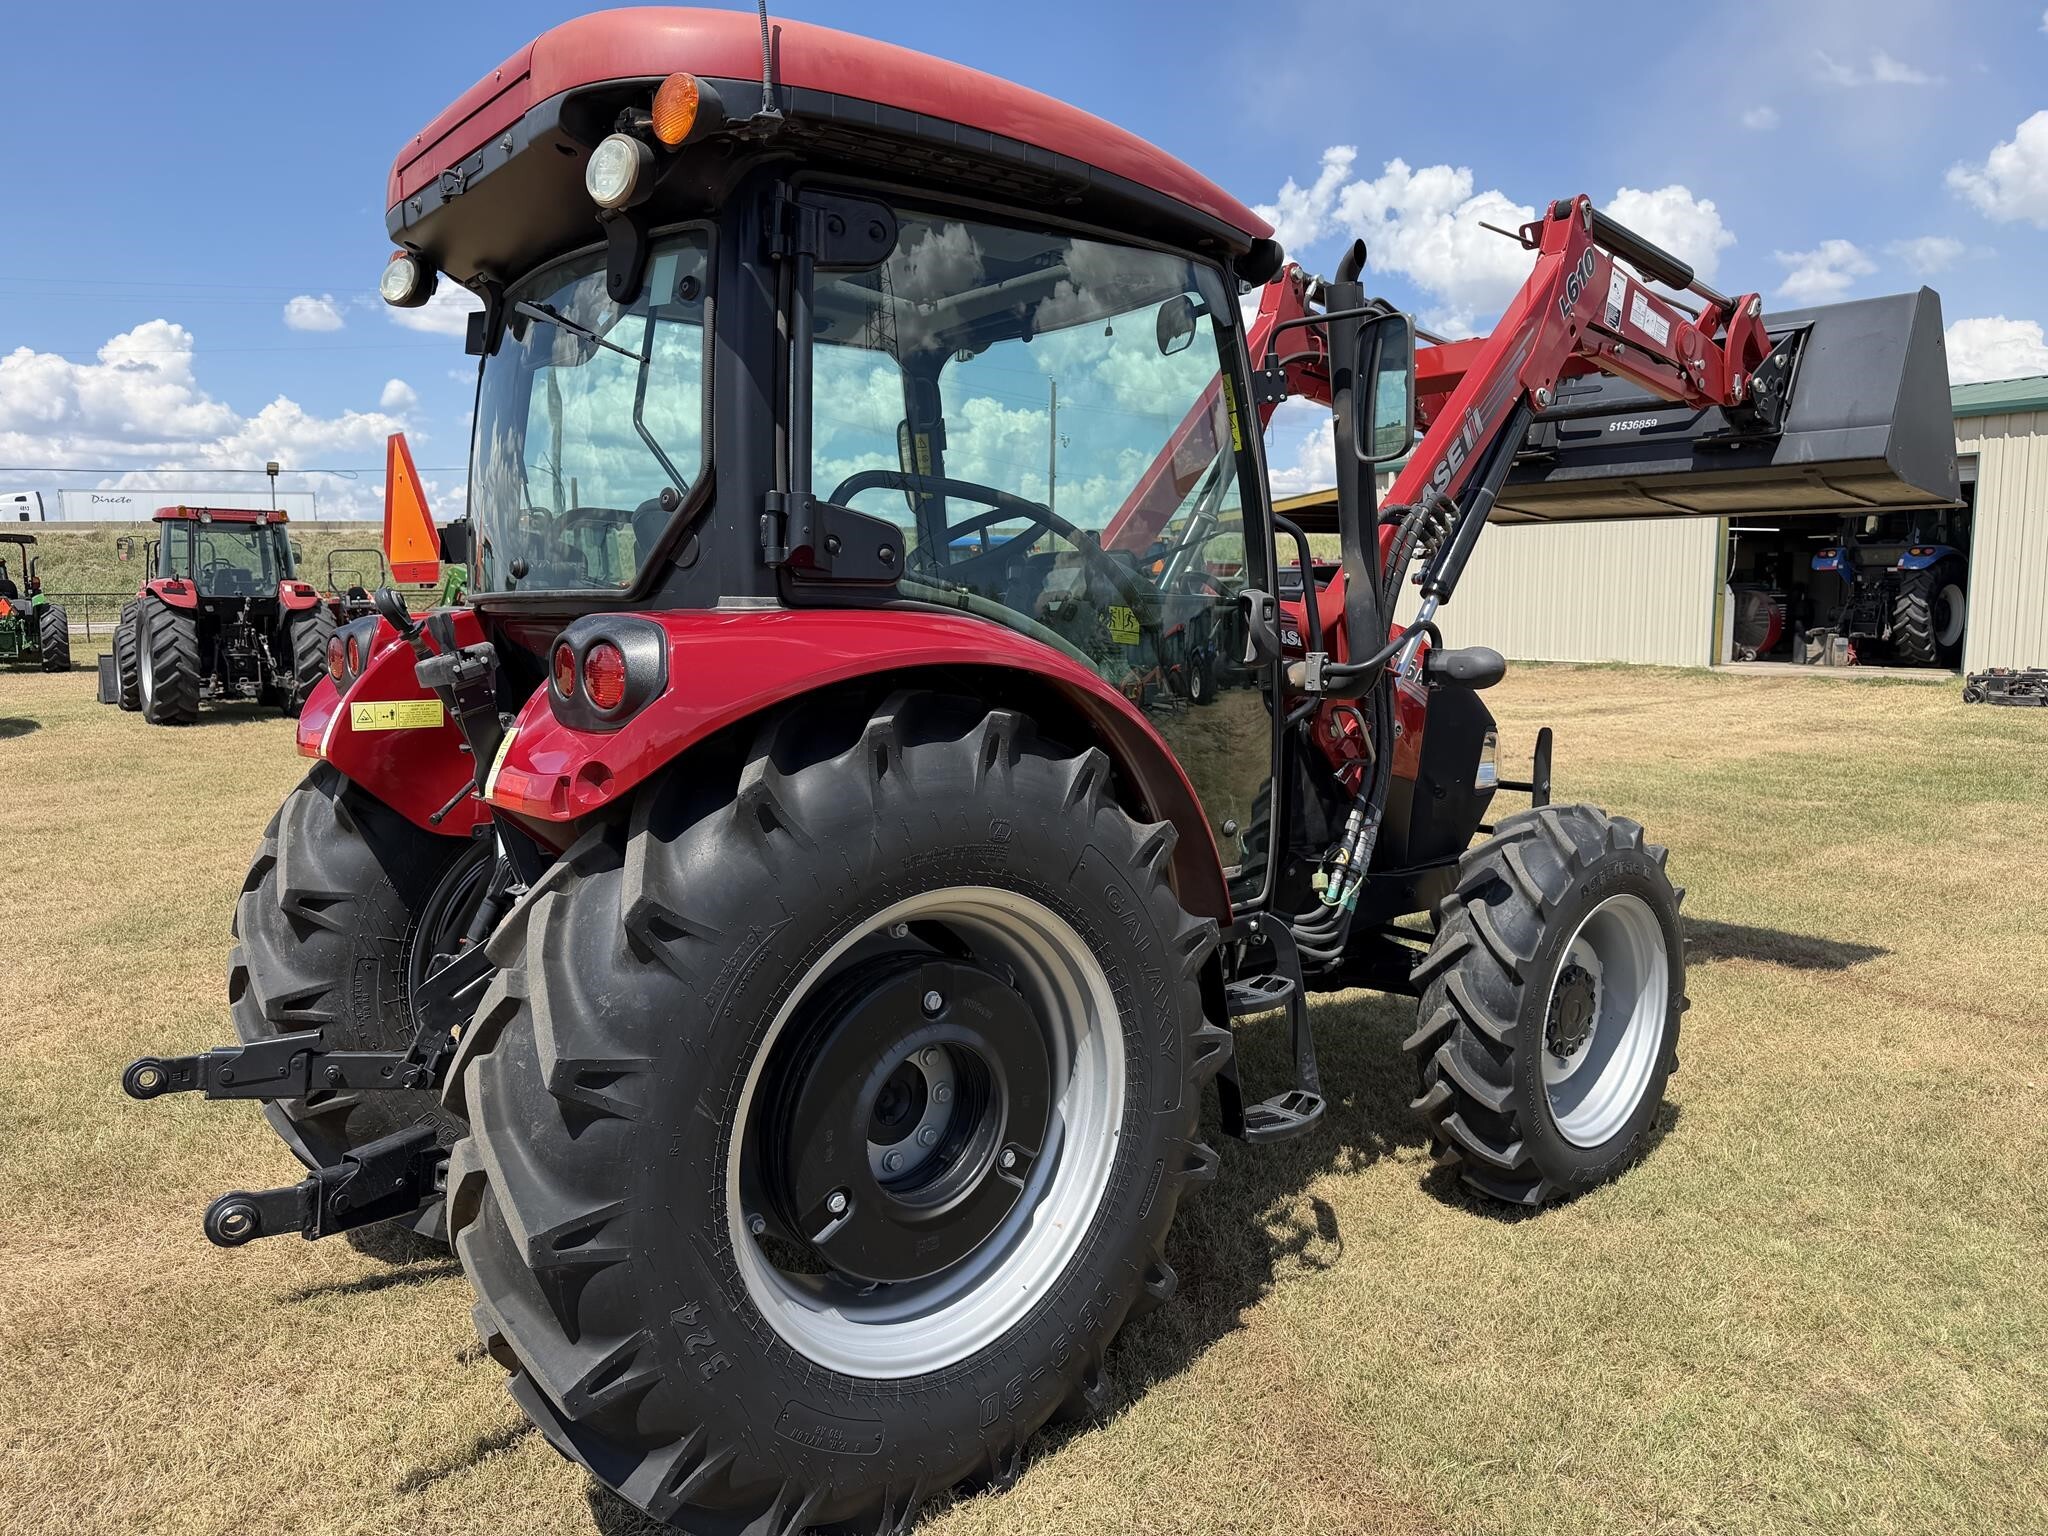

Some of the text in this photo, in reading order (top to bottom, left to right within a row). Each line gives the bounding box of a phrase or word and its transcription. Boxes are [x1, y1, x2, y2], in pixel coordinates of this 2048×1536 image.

[1558, 246, 1596, 320] L610
[1608, 418, 1658, 432] 51536859
[91, 494, 132, 504] Directo
[1422, 436, 1465, 503] ASE
[703, 924, 762, 1008] DIRECTION
[723, 945, 771, 1017] OF ROTATION
[1103, 883, 1176, 1062] GALAXY
